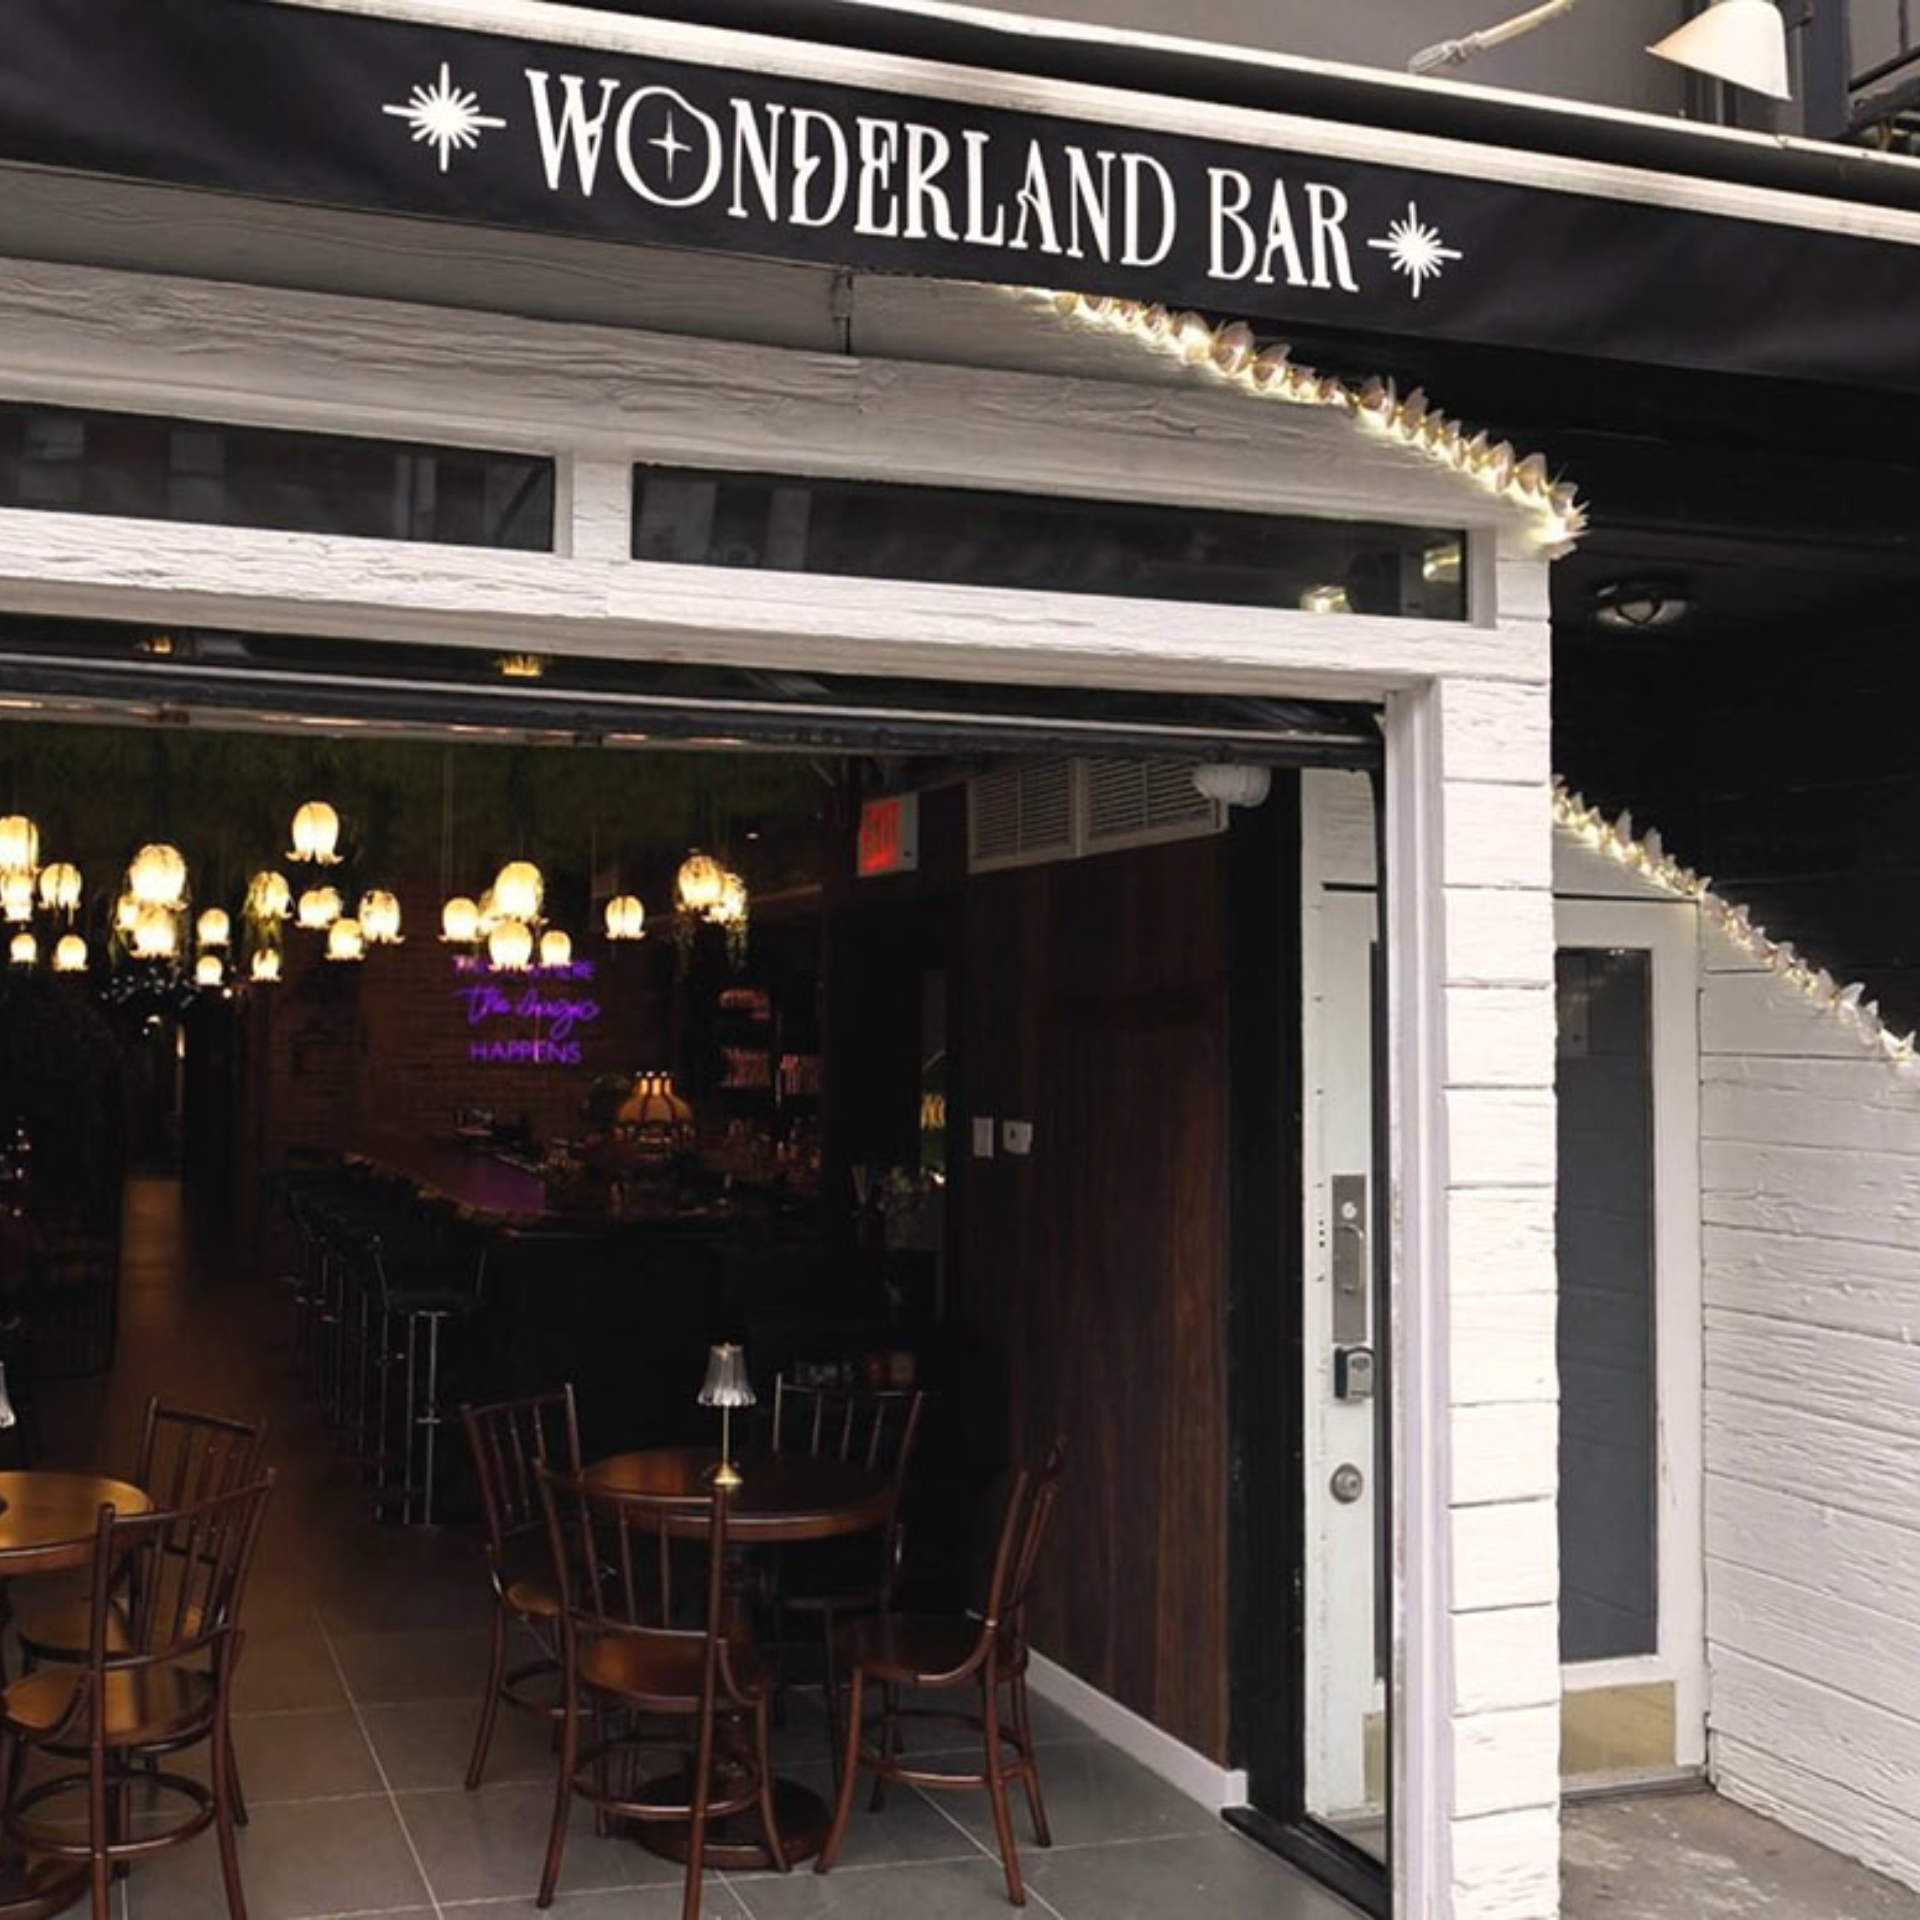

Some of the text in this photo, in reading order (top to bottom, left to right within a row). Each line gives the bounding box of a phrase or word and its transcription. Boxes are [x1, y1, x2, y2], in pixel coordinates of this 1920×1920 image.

[525, 69, 1359, 292] WONDERLAND BAR
[470, 1039, 584, 1065] HAPPENS
